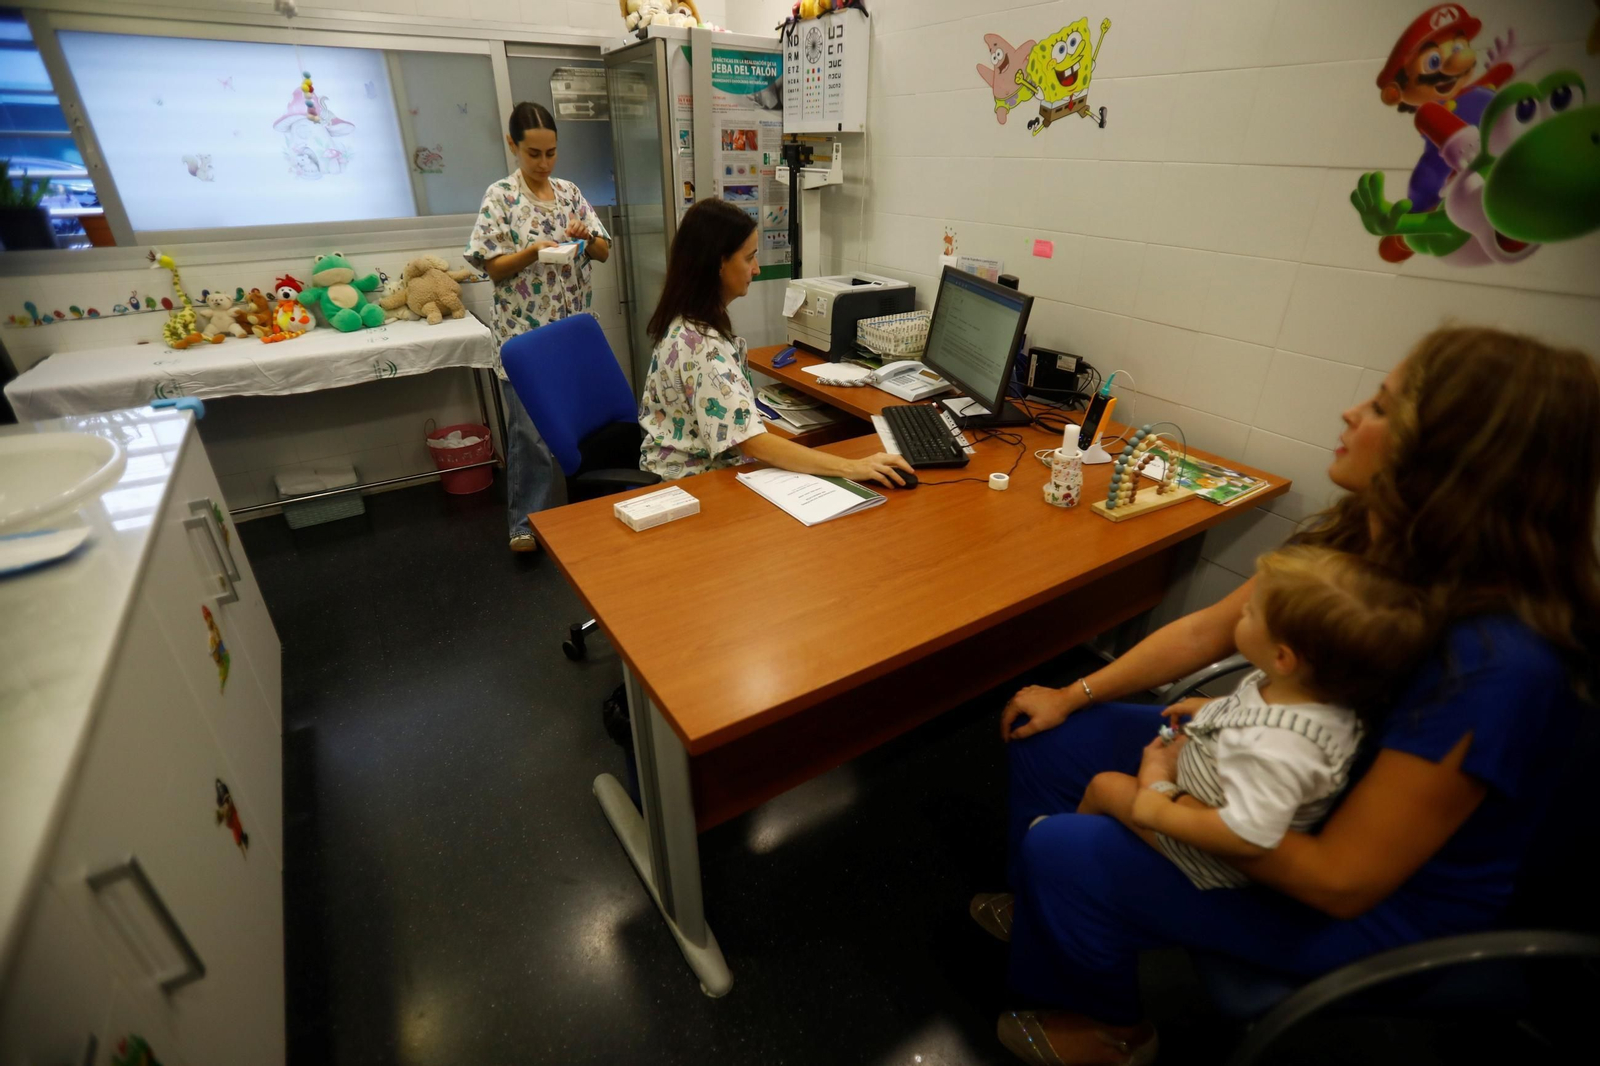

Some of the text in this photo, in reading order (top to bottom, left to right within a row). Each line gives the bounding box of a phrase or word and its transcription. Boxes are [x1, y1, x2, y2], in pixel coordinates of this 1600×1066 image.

[712, 63, 777, 76] UEBA DEL TALÓN
